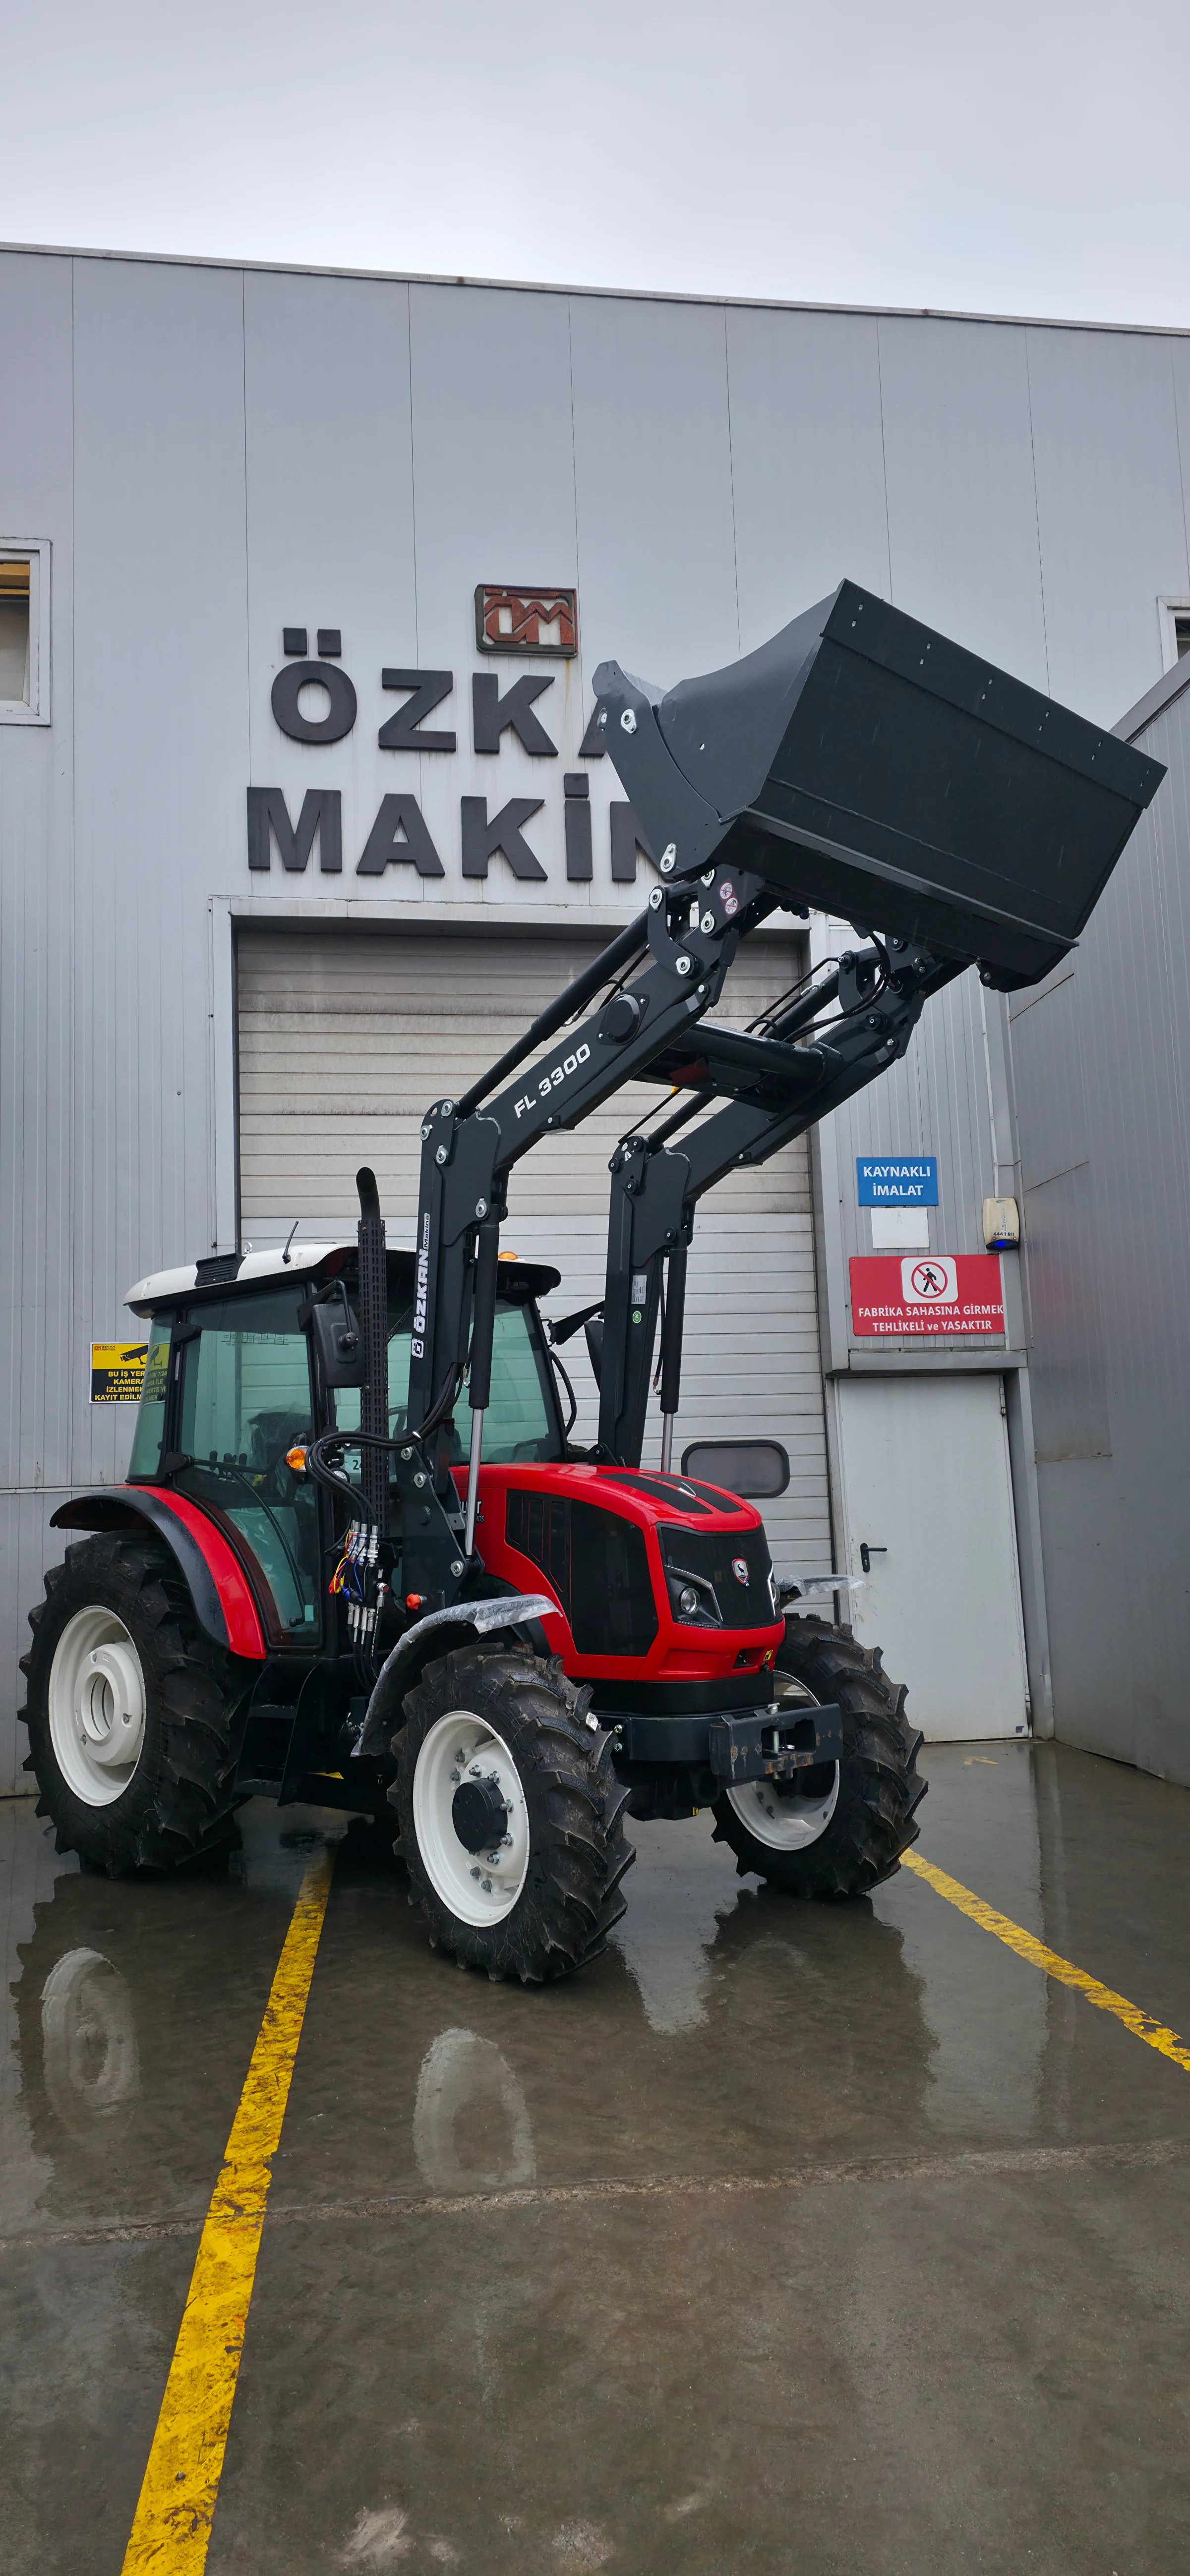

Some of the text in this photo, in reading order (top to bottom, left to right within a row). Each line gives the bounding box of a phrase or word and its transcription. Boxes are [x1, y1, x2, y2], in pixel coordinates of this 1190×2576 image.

[514, 1043, 590, 1118] FL 3300
[864, 1166, 930, 1177] KAYNAKLI
[873, 1183, 923, 1196] İMALAT
[414, 1249, 428, 1333] ÖZKAN
[859, 1304, 1004, 1317] FABRİKA SAHASINA GİRMEK
[873, 1320, 924, 1331] TEHLİKELİ
[942, 1320, 992, 1330] YASAKTIR
